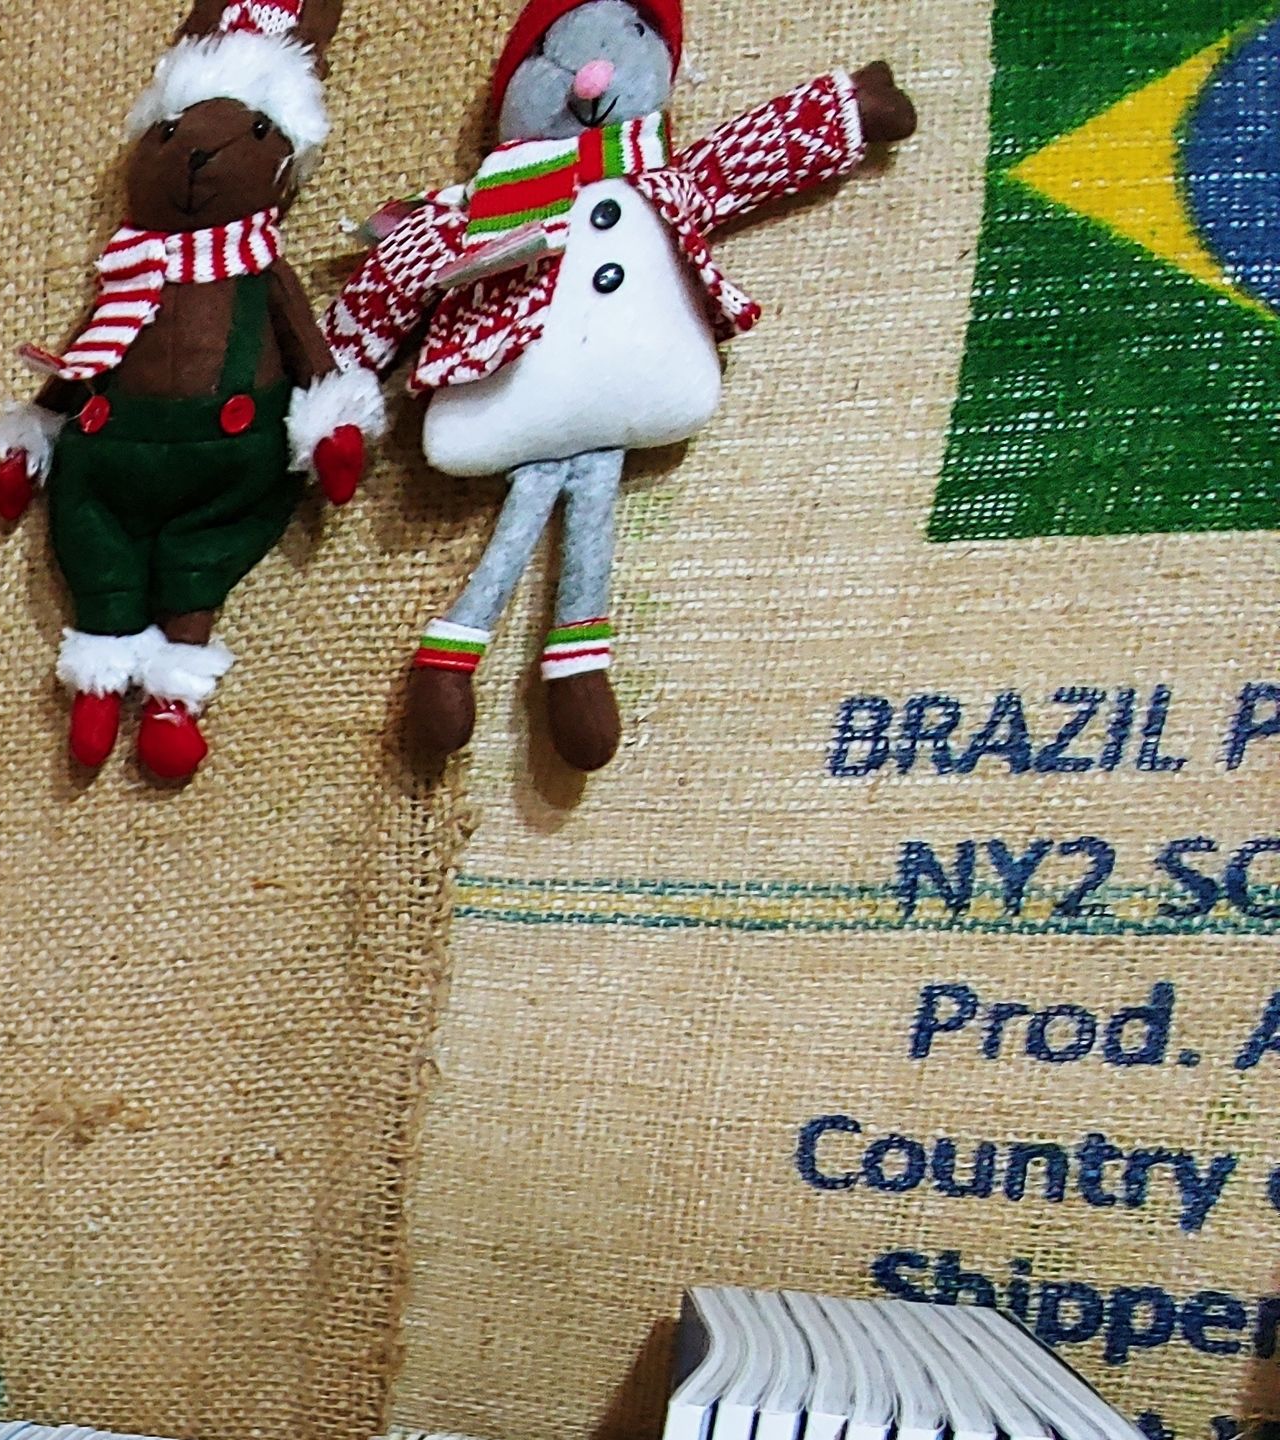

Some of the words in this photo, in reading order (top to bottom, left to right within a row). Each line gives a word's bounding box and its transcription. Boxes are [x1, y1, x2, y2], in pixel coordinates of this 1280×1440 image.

[828, 683, 1188, 778] BRAZIL
[896, 835, 1117, 918] NY2
[908, 981, 1202, 1068] Prod.
[795, 1113, 1238, 1233] Country
